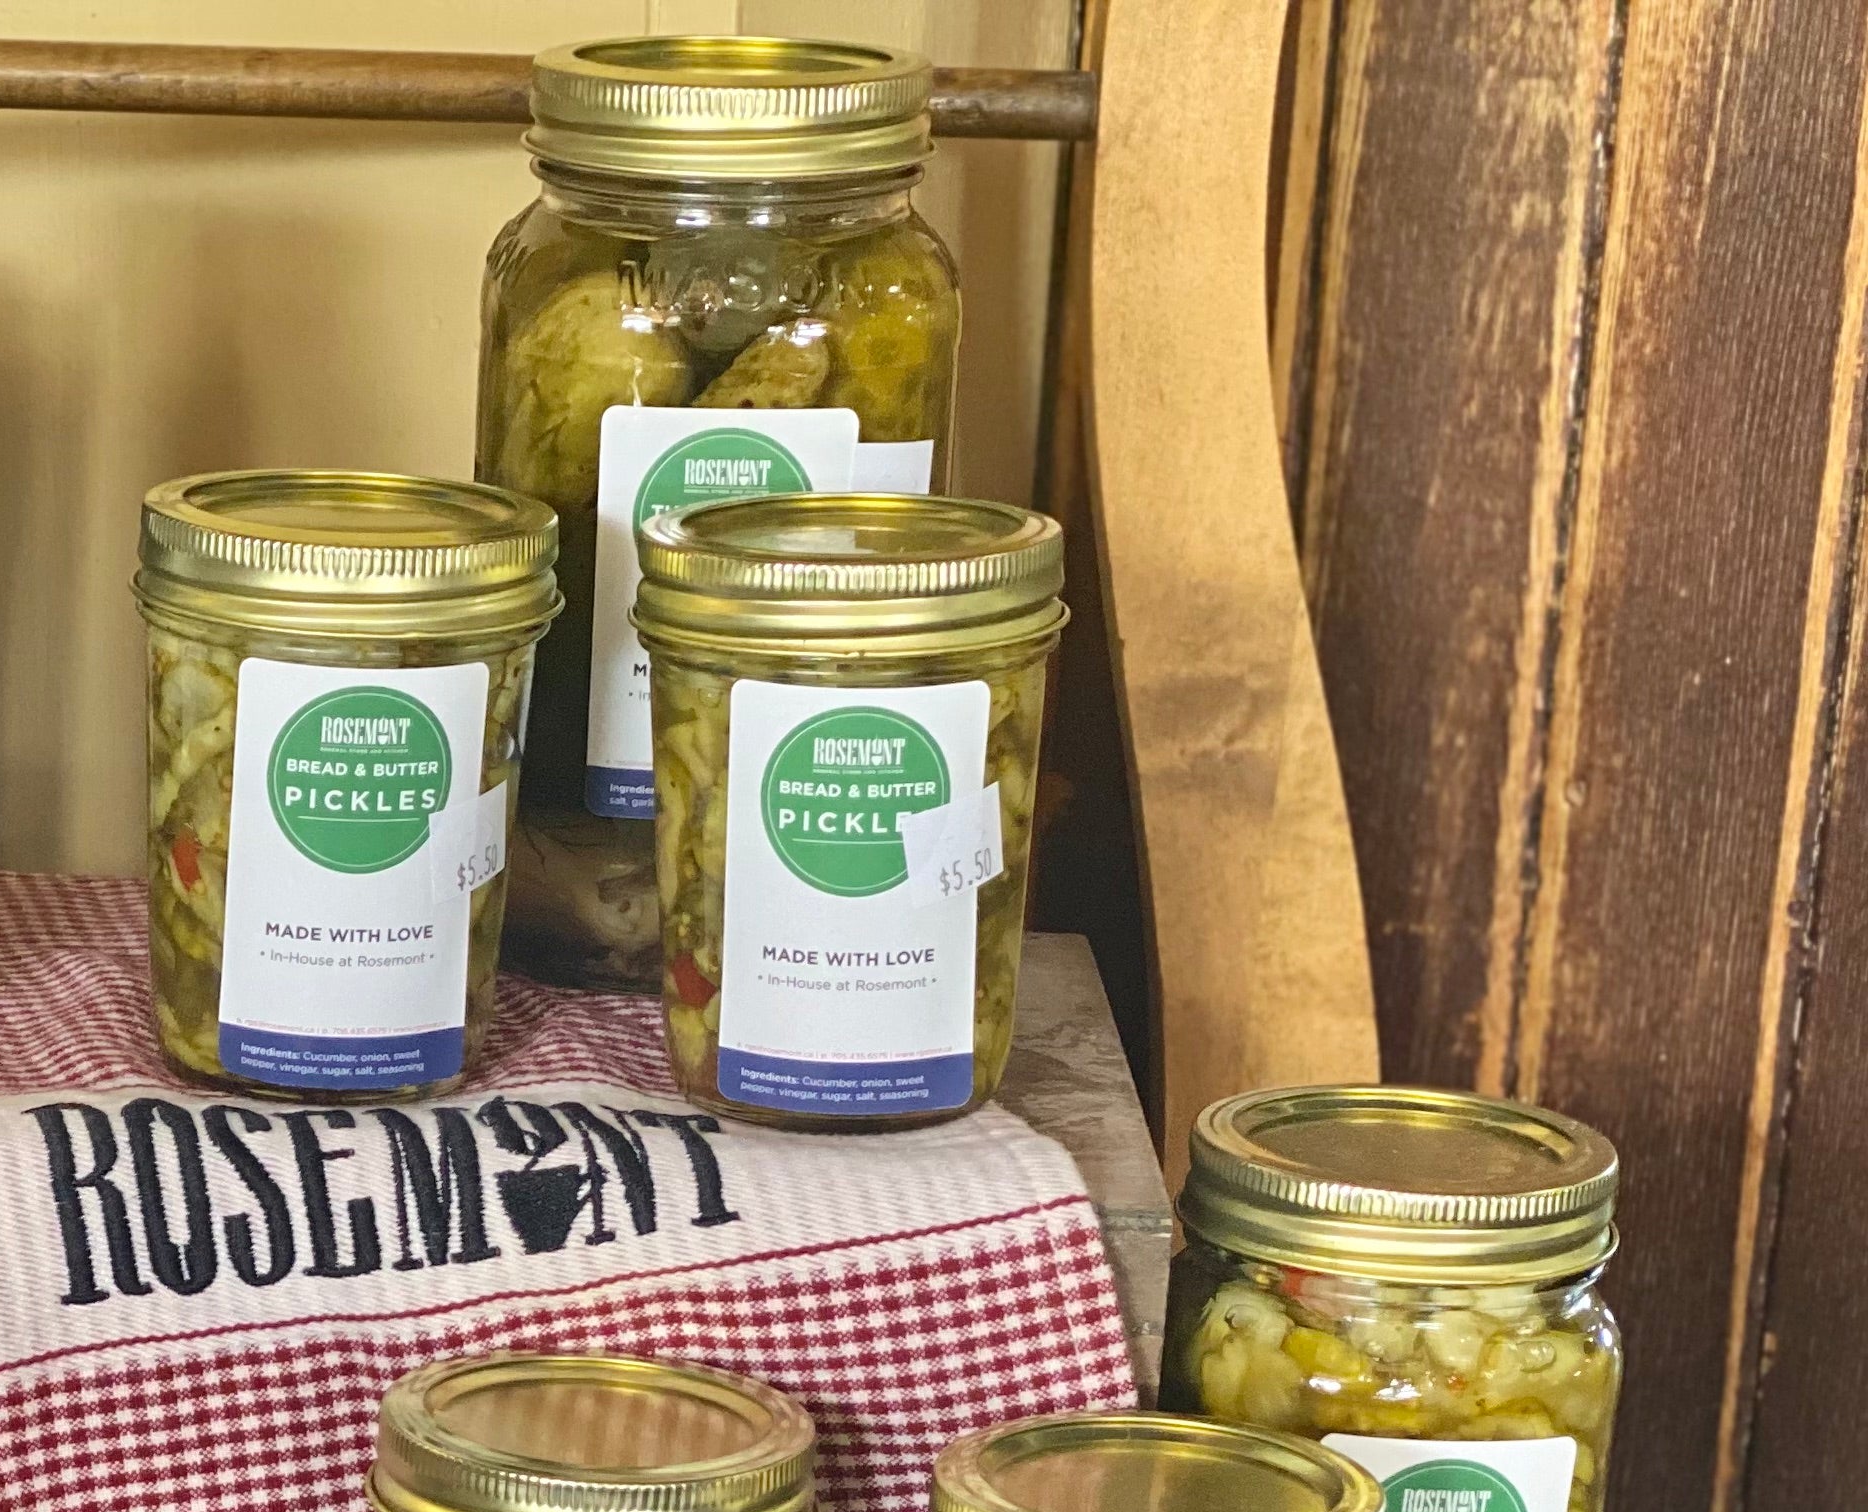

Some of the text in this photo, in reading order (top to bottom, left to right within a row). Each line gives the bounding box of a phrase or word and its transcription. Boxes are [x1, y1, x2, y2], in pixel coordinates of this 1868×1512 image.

[684, 458, 771, 485] ROSEMONT
[321, 716, 410, 746] ROSEMONT
[813, 737, 906, 766] ROSEMONT
[287, 759, 438, 776] BREAD & BUTTER
[285, 785, 436, 811] PICKLES
[779, 781, 935, 798] BREAD & BUTTER
[456, 844, 497, 891] $5.50
[940, 849, 991, 897] $5.50
[266, 922, 433, 942] MADE WITH LOVE
[270, 950, 425, 967] In-House at Rosemont
[763, 945, 935, 966] MADE WITH LOVE
[767, 975, 926, 992] In-House at Rosemont
[22, 1095, 740, 1305] ROSEMONT
